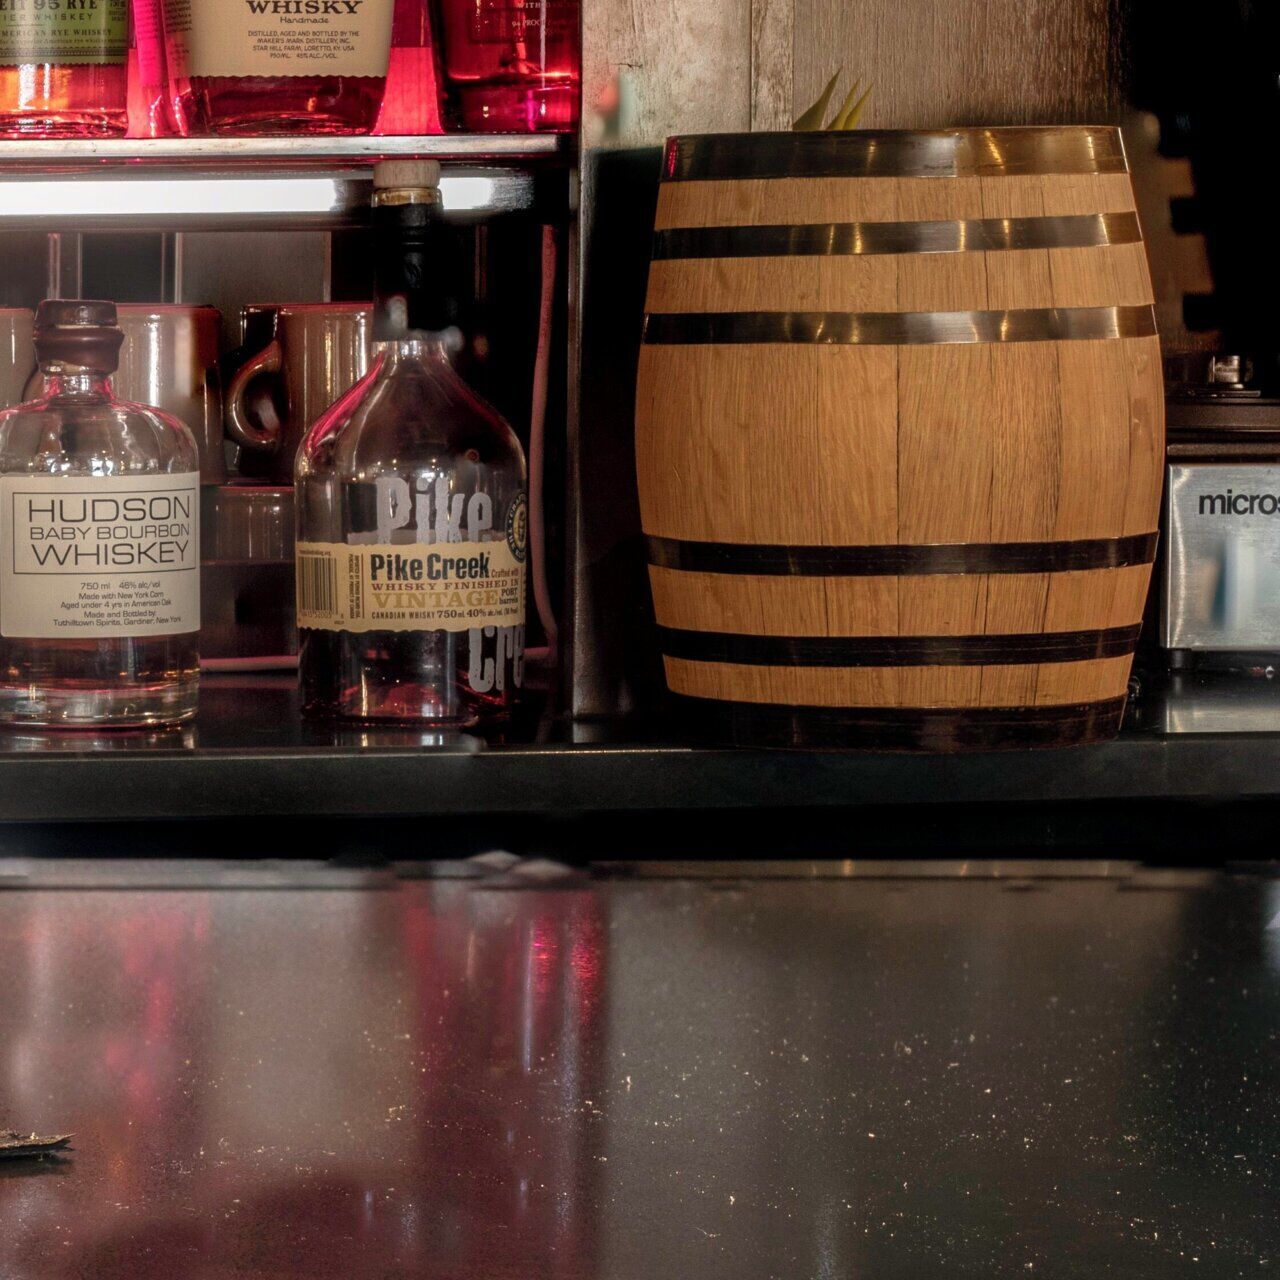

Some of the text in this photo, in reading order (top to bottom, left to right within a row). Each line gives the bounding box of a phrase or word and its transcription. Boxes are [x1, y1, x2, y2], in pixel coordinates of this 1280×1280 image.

[246, 0, 363, 14] WHISKY
[280, 16, 329, 24] Handmade
[29, 495, 190, 522] HUDSON
[375, 476, 493, 544] Pike
[1199, 489, 1280, 516] micro
[31, 523, 189, 540] BABY BOURBON
[31, 540, 189, 566] WHISKEY
[370, 552, 489, 581] Pike Creek
[371, 578, 519, 591] WHISKY FINISHED IN
[79, 592, 99, 600] Made
[100, 592, 116, 600] with
[372, 590, 499, 609] VINTAGE
